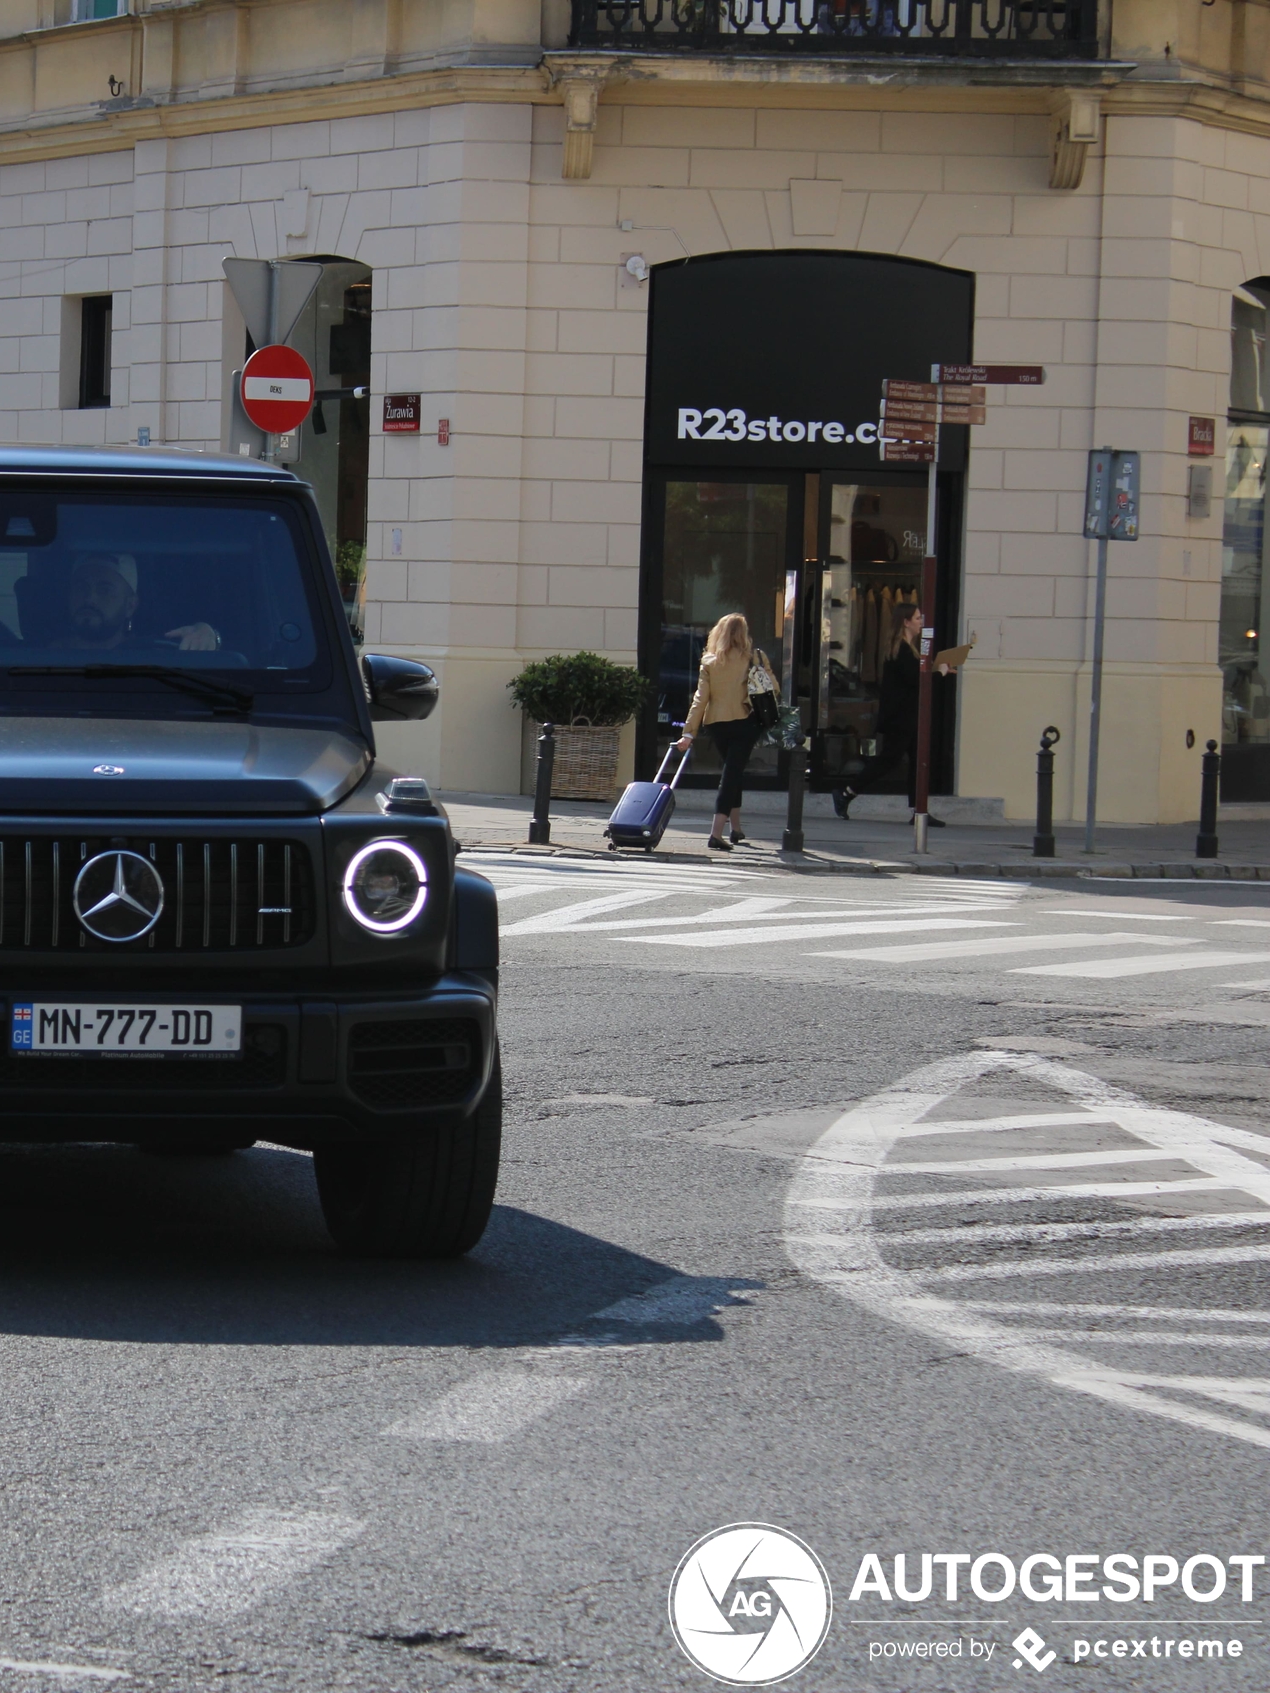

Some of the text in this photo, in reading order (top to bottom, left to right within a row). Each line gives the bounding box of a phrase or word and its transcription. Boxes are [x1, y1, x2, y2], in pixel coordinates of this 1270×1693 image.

[943, 366, 957, 374] Trakt
[943, 373, 953, 381] The
[955, 374, 970, 383] Royal
[386, 401, 414, 419] Żurawia
[677, 408, 932, 445] R23store.c
[39, 1008, 213, 1045] MN-777-DD
[14, 1030, 30, 1044] GE
